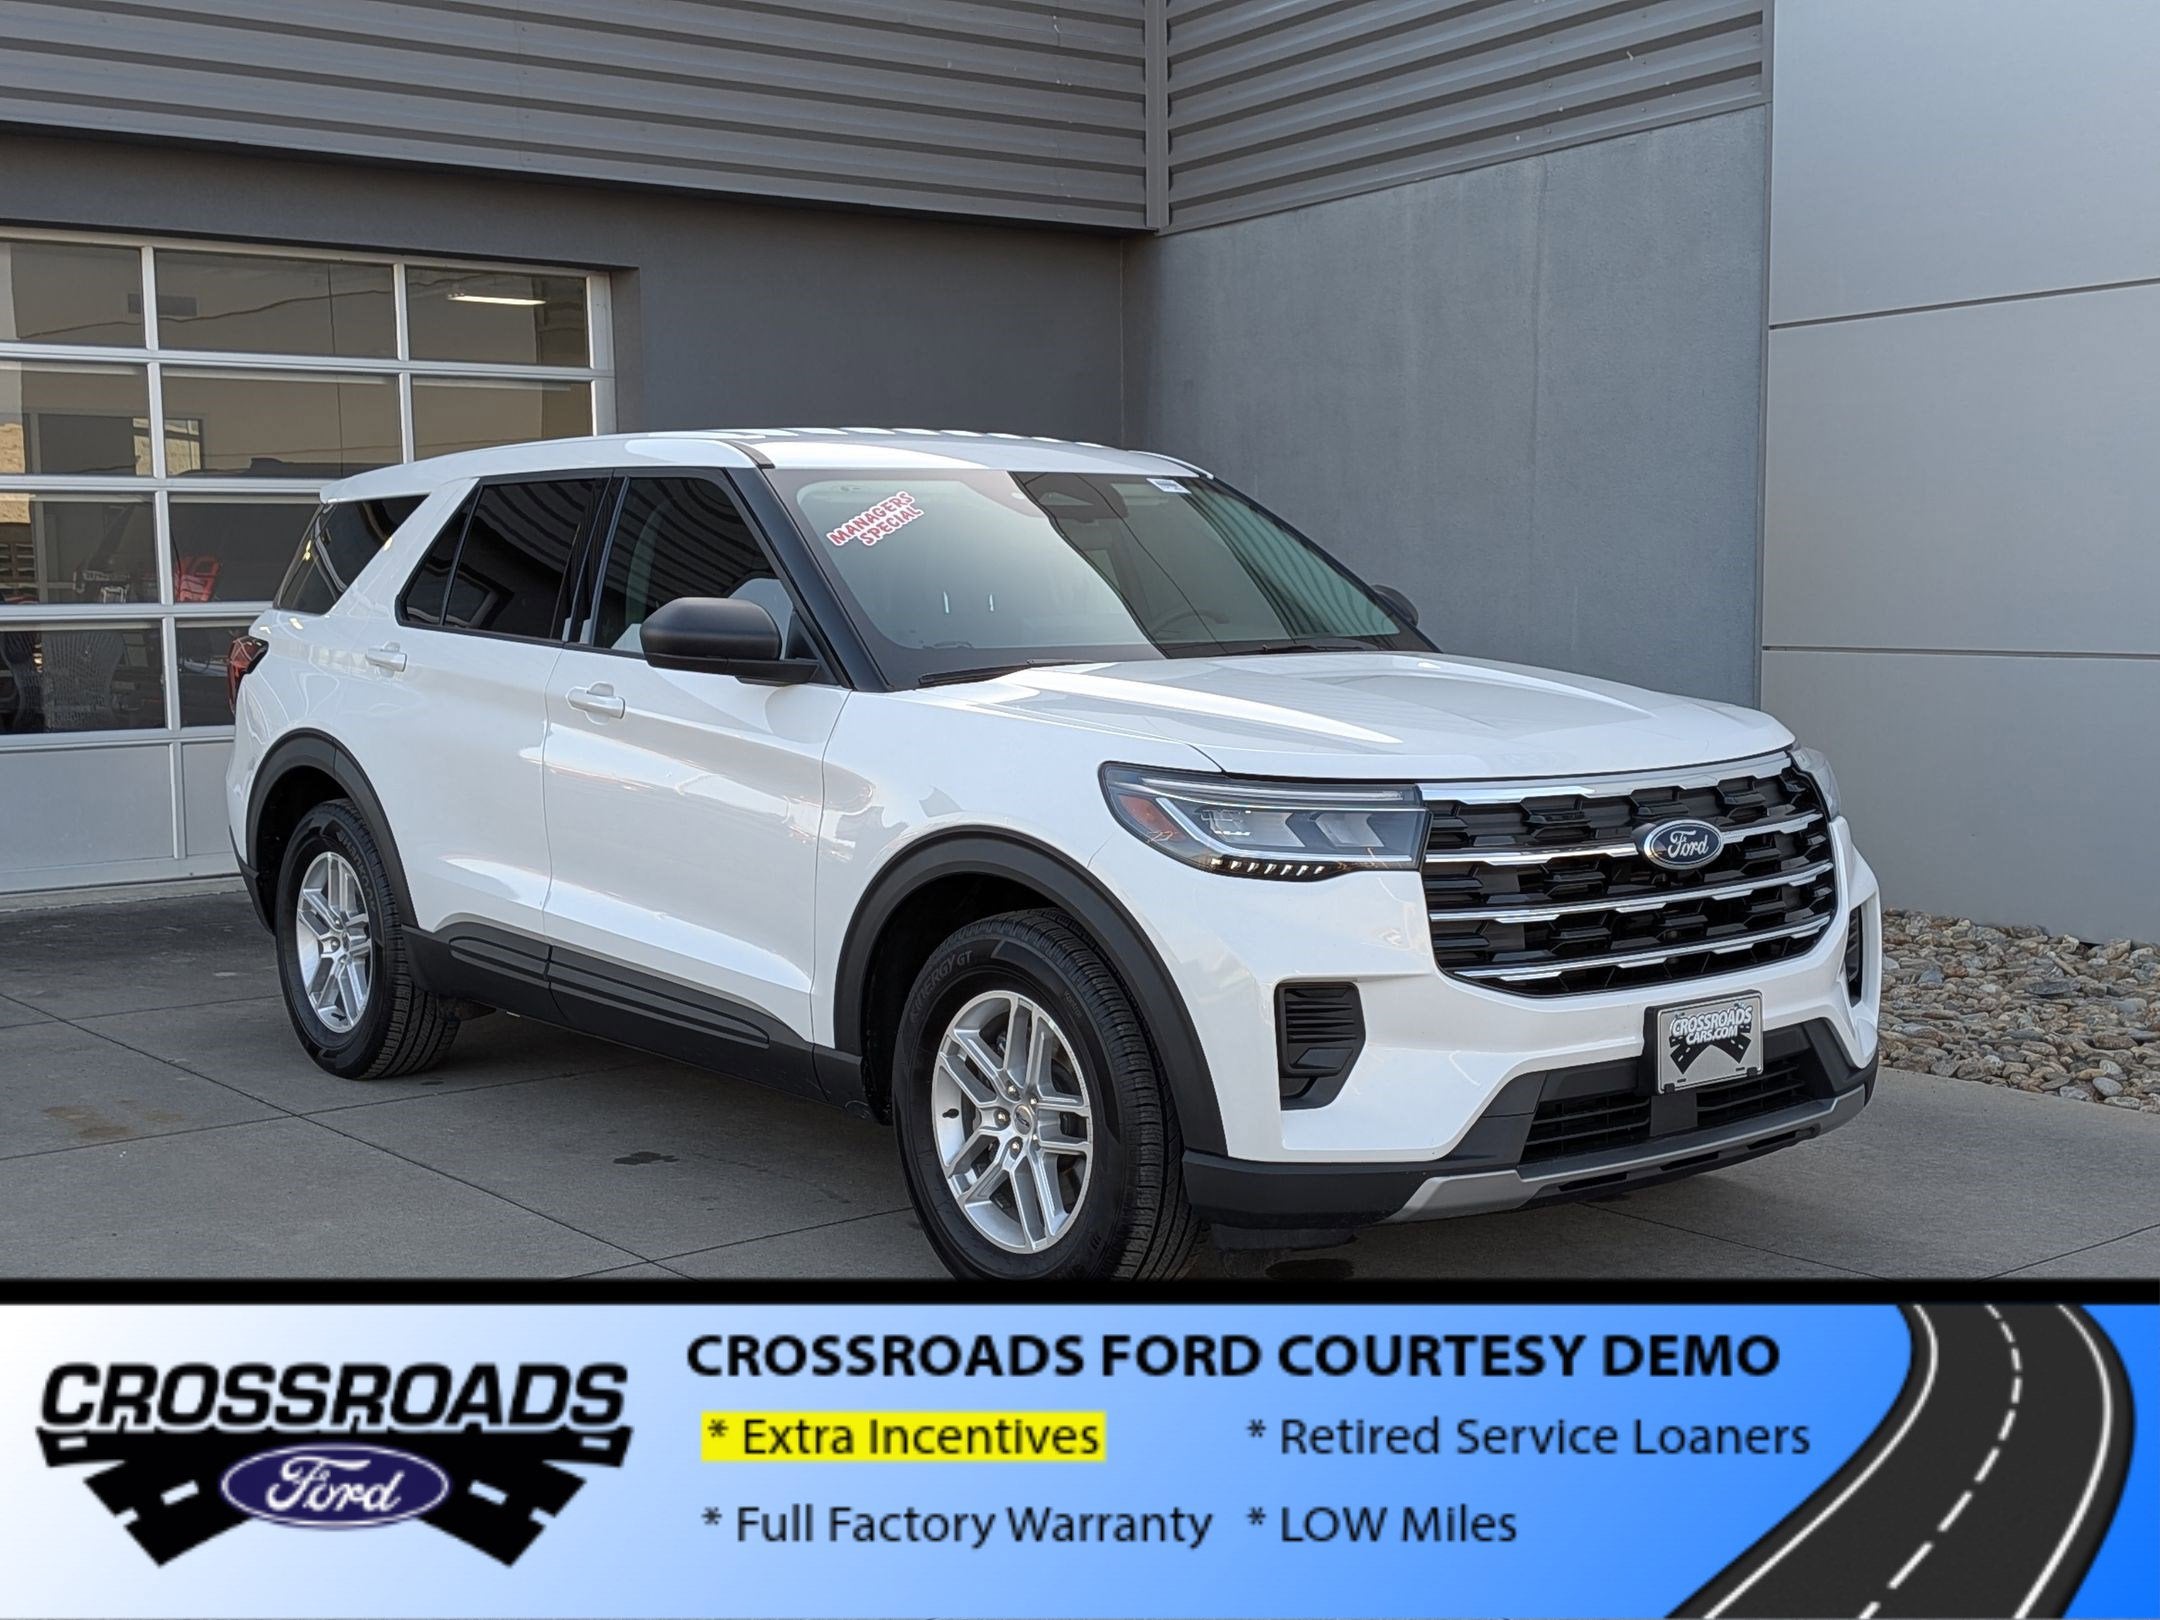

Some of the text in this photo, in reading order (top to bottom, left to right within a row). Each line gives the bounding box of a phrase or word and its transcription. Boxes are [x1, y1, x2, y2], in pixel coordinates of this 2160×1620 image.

[830, 492, 914, 545] MANAGERS
[859, 506, 922, 545] SPECIAL
[1667, 829, 1710, 859] Ford
[1672, 1006, 1753, 1037] CROSSROADS
[1686, 1025, 1739, 1046] CARS.COM
